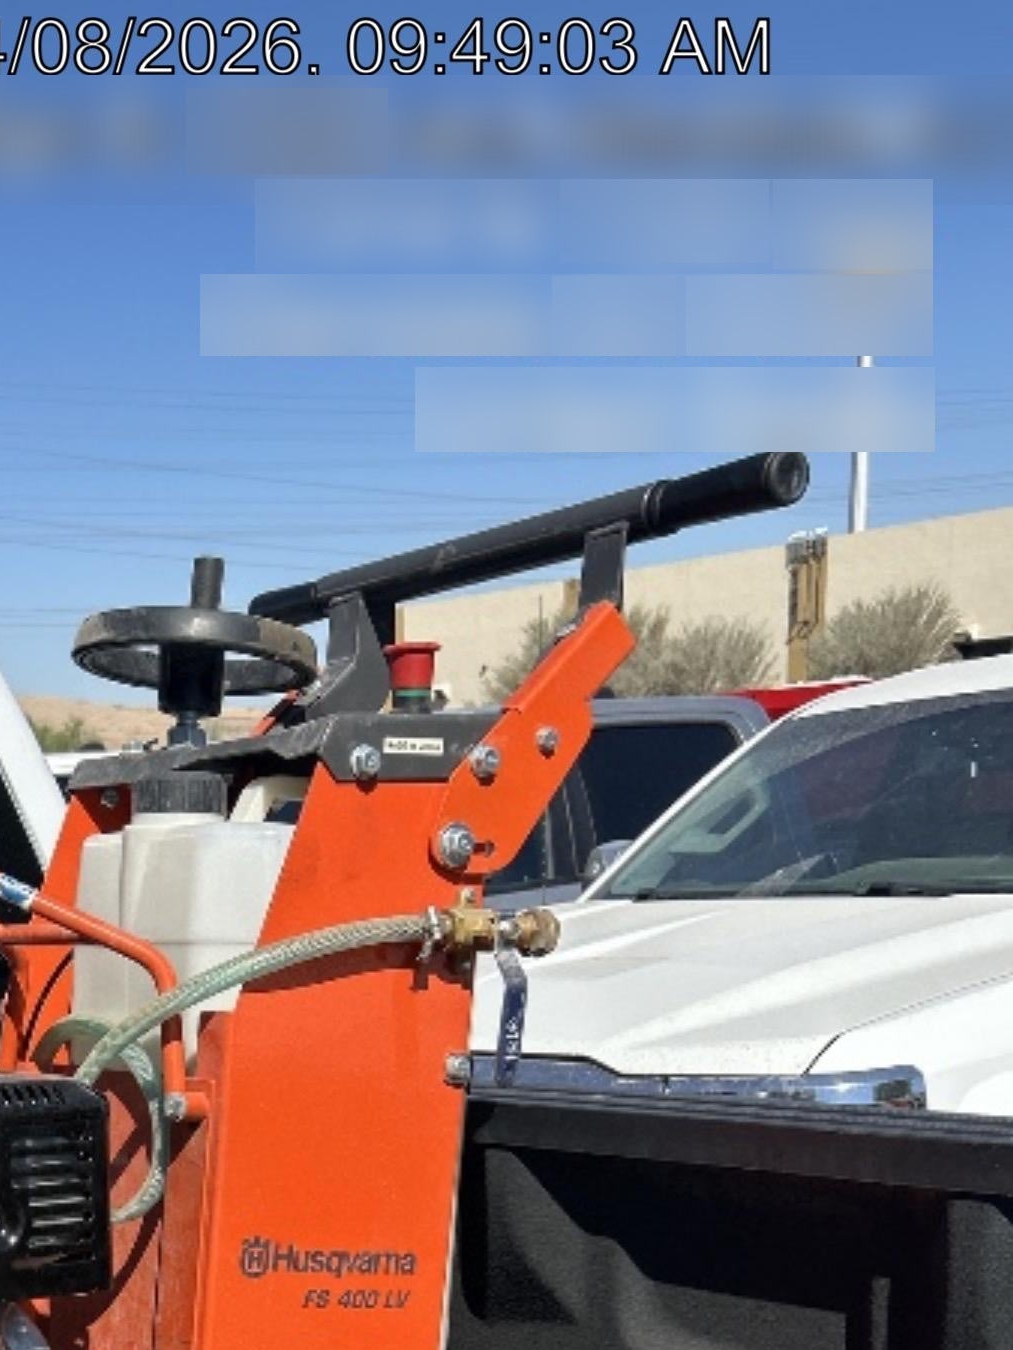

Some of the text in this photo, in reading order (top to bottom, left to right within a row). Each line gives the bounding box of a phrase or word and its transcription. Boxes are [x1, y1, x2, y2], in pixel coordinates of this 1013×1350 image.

[272, 1242, 416, 1278] Husqvarna
[301, 1289, 331, 1310] FS
[338, 1289, 379, 1310] 400
